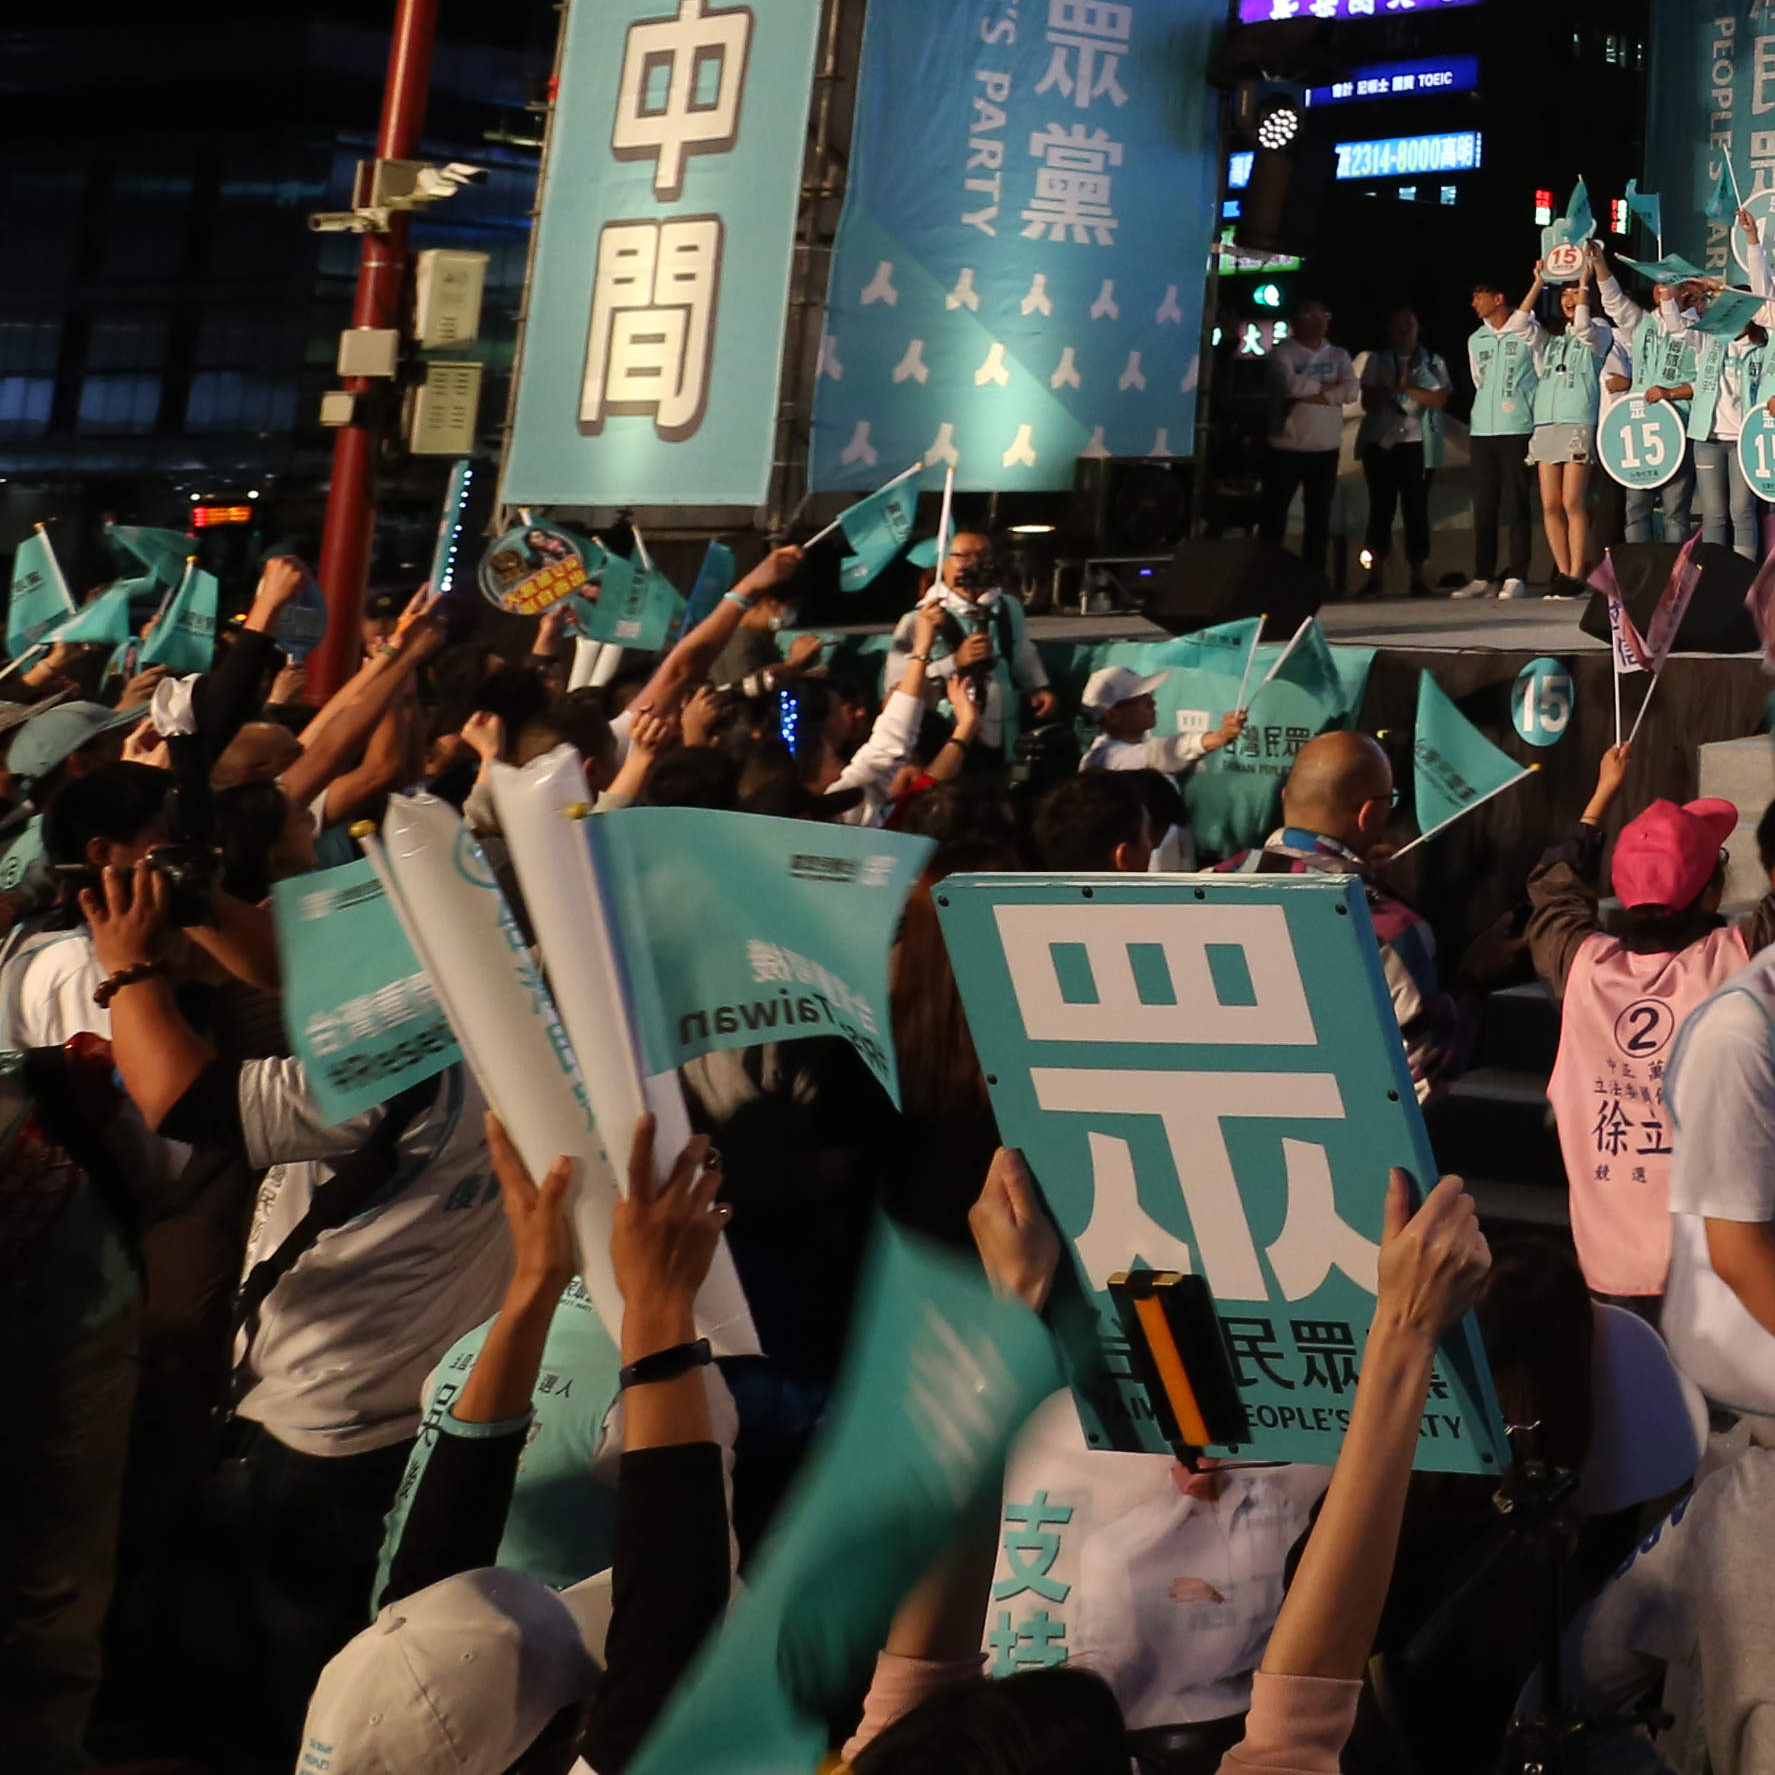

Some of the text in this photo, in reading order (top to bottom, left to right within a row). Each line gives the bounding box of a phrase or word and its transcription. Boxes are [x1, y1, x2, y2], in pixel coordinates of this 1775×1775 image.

[1418, 71, 1453, 88] TOEIC
[960, 66, 1014, 238] PARTY
[1552, 249, 1577, 265] 15
[1630, 401, 1646, 420] 眾
[1619, 422, 1666, 470] 15
[1518, 675, 1571, 733] 15
[1225, 725, 1311, 758] 灣民眾
[992, 904, 1382, 1303] 眾
[1591, 1099, 1673, 1157] 徐立
[1096, 1315, 1450, 1400] 台民眾
[1245, 1401, 1350, 1433] EOPLE'S
